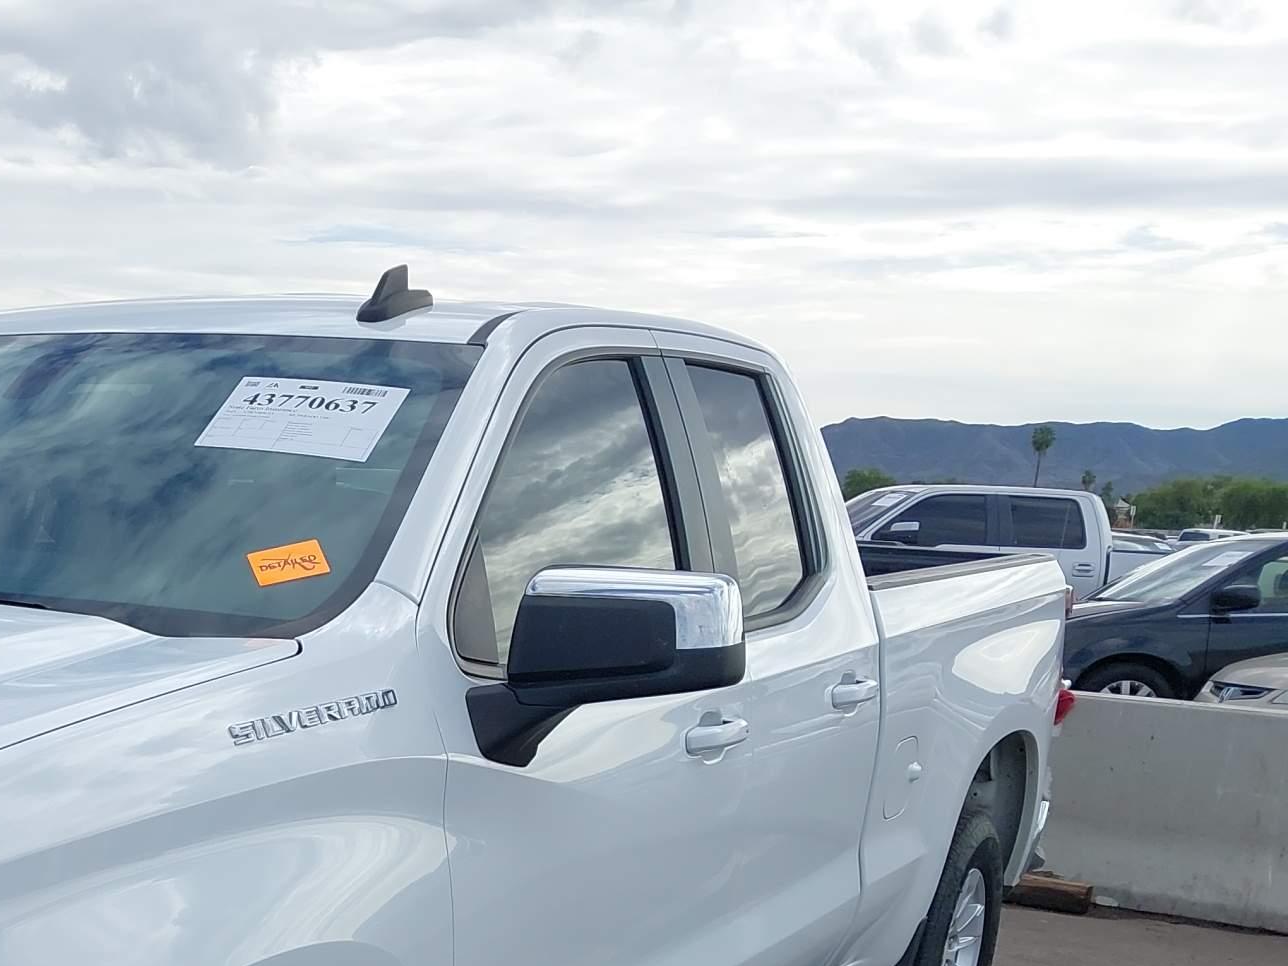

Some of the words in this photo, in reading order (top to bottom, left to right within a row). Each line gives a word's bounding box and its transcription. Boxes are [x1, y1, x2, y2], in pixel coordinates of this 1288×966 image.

[243, 392, 379, 414] 43770637
[259, 553, 319, 572] DETAILED
[228, 688, 398, 746] SILVERADO
